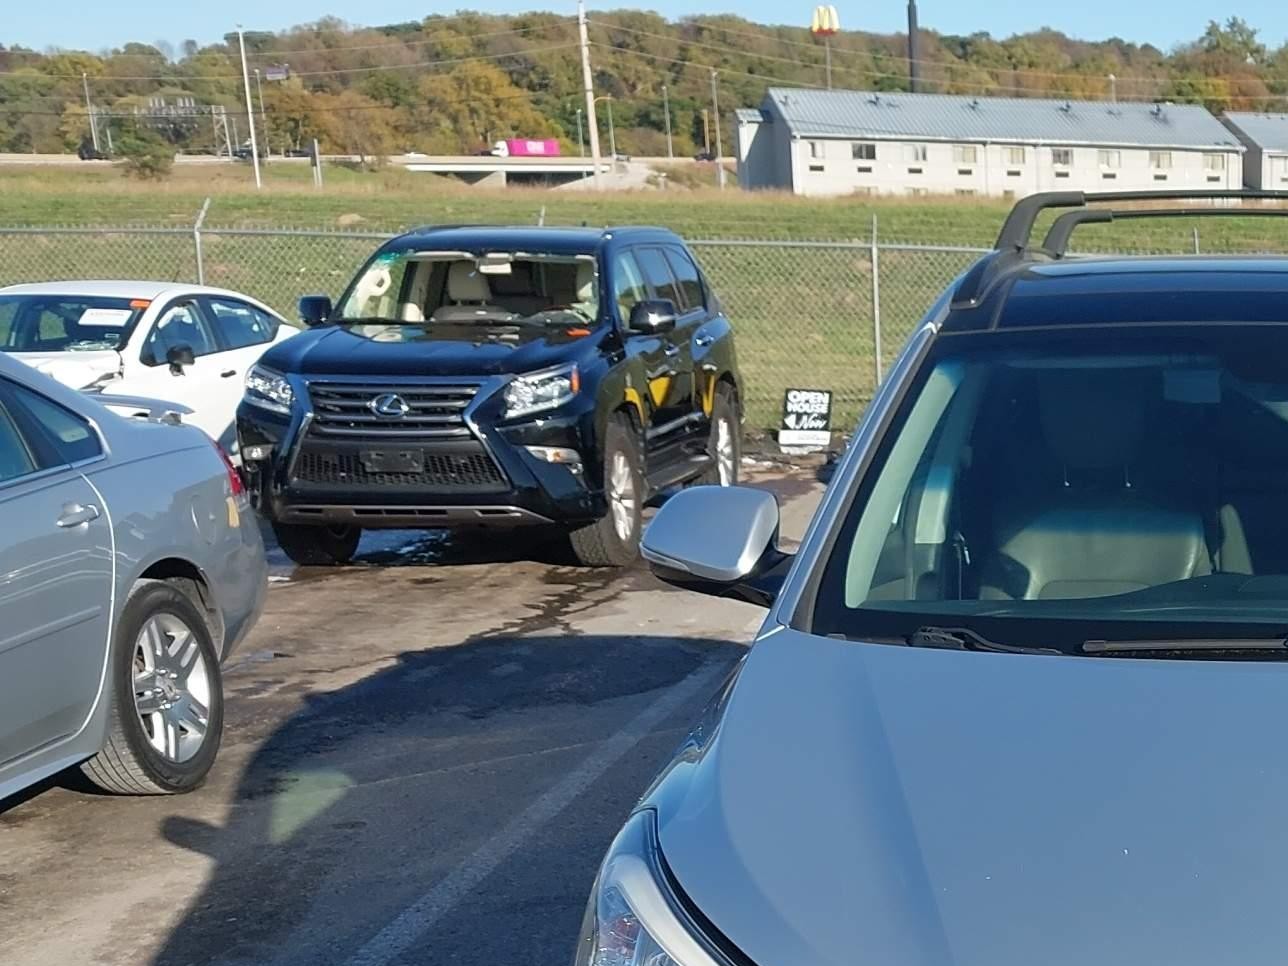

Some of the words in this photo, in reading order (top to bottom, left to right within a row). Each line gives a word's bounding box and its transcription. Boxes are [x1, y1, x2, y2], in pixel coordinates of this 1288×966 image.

[787, 390, 830, 404] OPEN
[786, 401, 829, 414] HOUSE
[796, 413, 827, 429] Now
